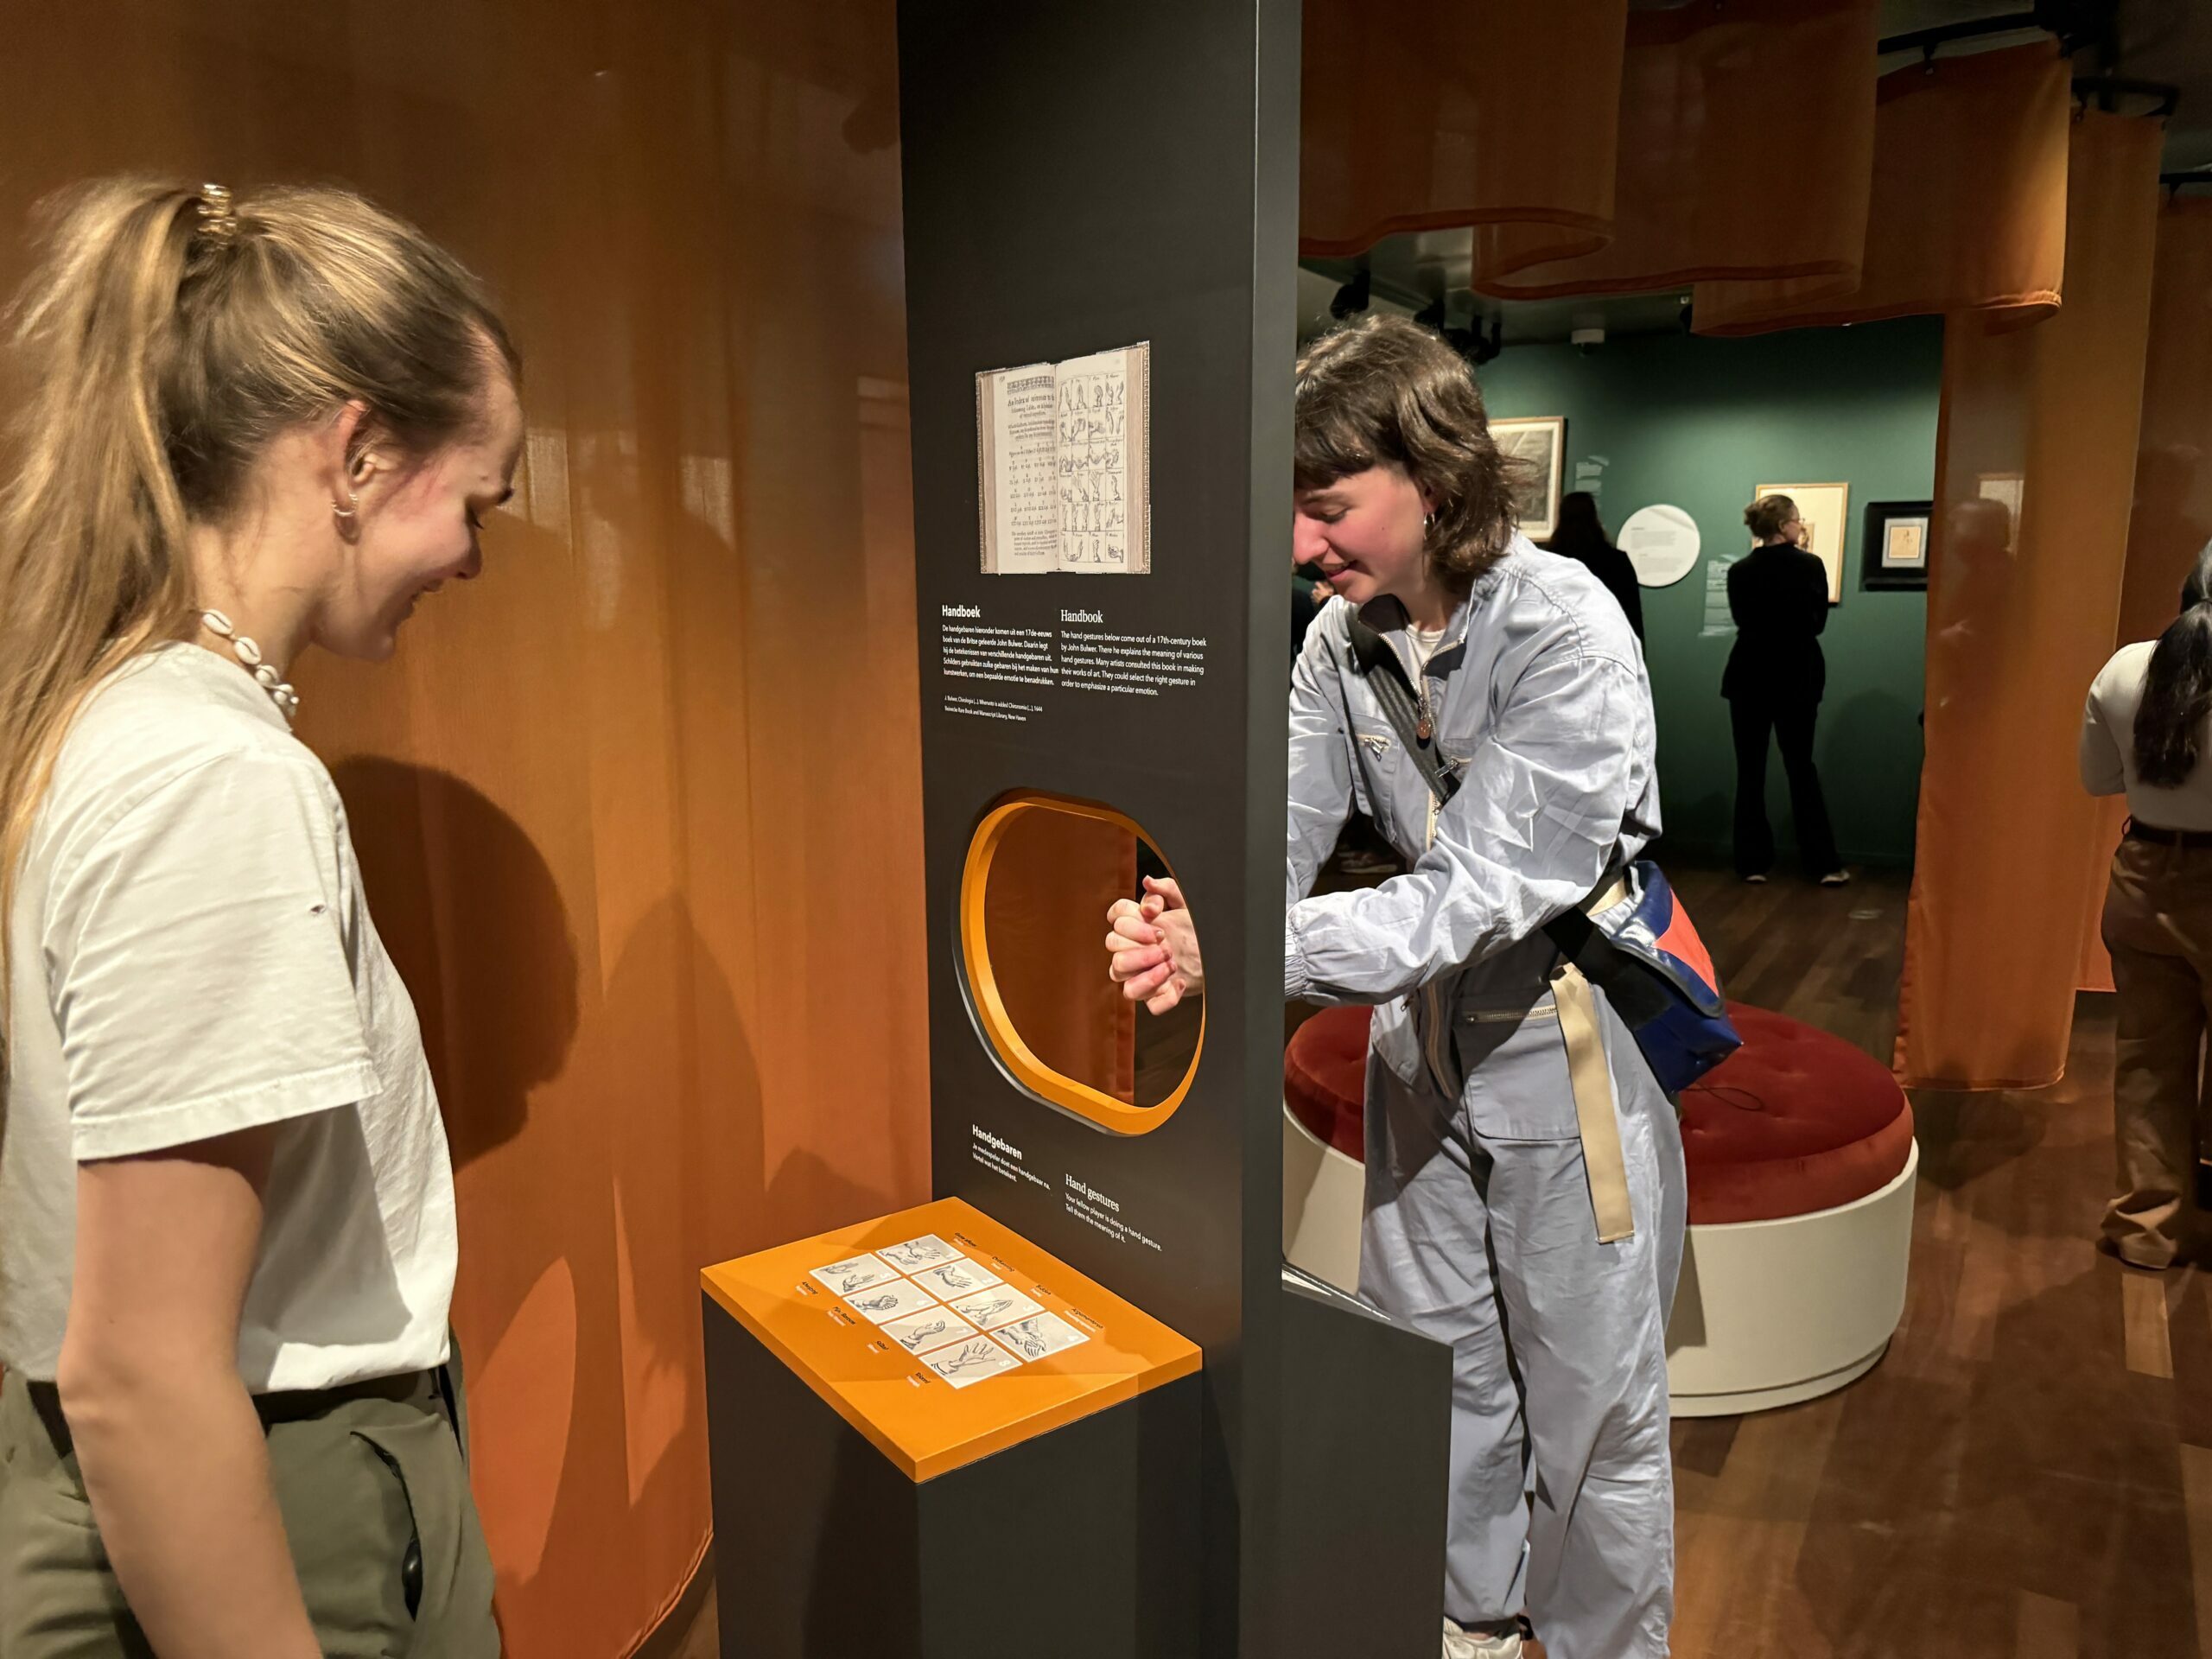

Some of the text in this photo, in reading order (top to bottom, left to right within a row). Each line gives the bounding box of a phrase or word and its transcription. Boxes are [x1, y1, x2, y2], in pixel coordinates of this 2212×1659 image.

[942, 605, 981, 618] Handboek
[1061, 609, 1103, 623] Handbook
[949, 625, 974, 634] handgebaren
[1025, 629, 1052, 638] 17de-eeuws
[1070, 631, 1082, 639] hand
[1105, 632, 1120, 641] below
[1146, 634, 1152, 643] of
[1157, 636, 1191, 647] 17th-century
[978, 638, 996, 646] geleerde
[1039, 641, 1048, 651] legt
[1061, 643, 1067, 652] by
[1080, 644, 1097, 652] Bulwer.
[1121, 647, 1141, 657] explains
[1152, 650, 1175, 659] meaning
[954, 647, 979, 656] betekenissen
[1015, 652, 1044, 661] handgebaren
[1096, 658, 1109, 667] Many
[1125, 660, 1150, 669] consulted
[1151, 661, 1161, 670] this
[1162, 662, 1176, 671] book
[1183, 664, 1204, 676] making
[984, 671, 1003, 681] bepaalde
[1025, 675, 1054, 685] benadrukken.
[1102, 671, 1114, 680] They
[1129, 673, 1144, 682] select
[1155, 675, 1168, 685] right
[1169, 677, 1189, 686] gesture
[1081, 682, 1106, 690] emphasize
[972, 1124, 1022, 1160] Handgebaren
[1065, 1173, 1120, 1212] Hand gestures
[1065, 1192, 1075, 1203] Your
[1076, 1197, 1089, 1211] fellow
[1090, 1206, 1104, 1219] player
[1110, 1217, 1123, 1232] doing
[1128, 1227, 1141, 1239] hand
[1142, 1236, 1162, 1251] gesture.
[1074, 1208, 1085, 1220] them
[1094, 1221, 1114, 1238] meaning
